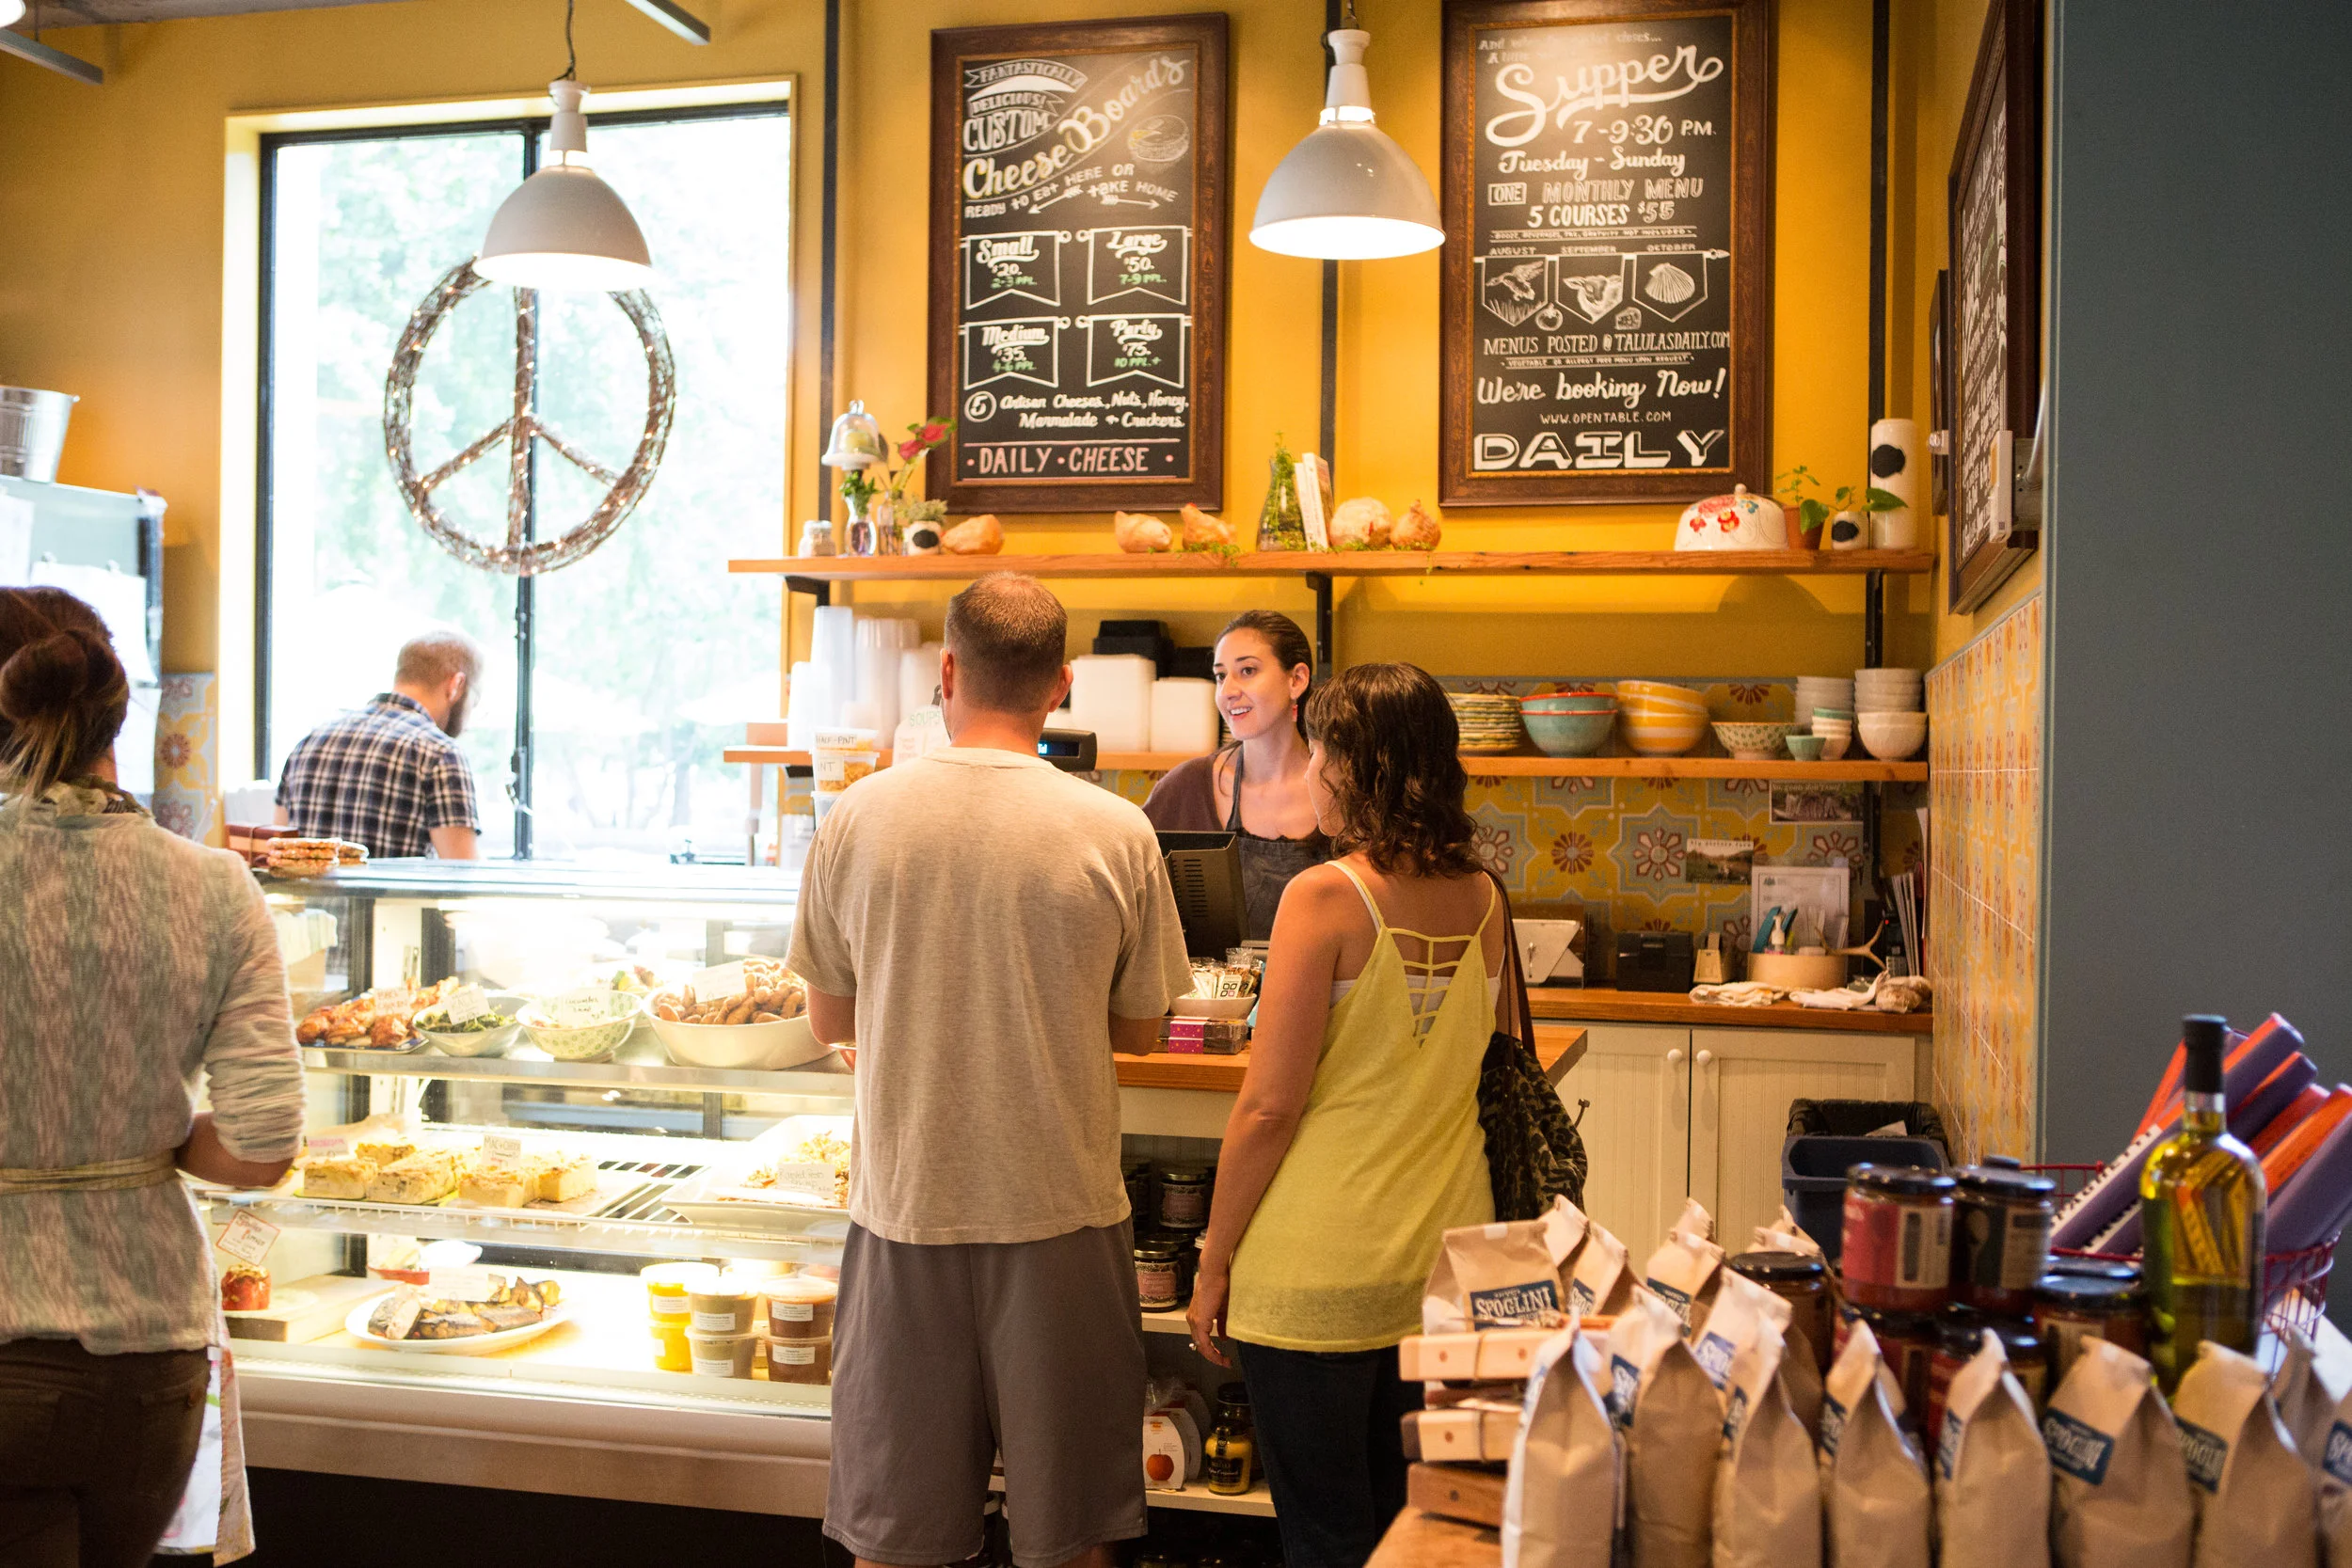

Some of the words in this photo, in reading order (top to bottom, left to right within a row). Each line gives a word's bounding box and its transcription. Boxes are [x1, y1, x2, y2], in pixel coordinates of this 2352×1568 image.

[1486, 44, 1724, 147] Supper
[963, 144, 1074, 199] Cheese
[1058, 55, 1191, 154] Boards
[963, 109, 1050, 151] CUSTOM
[1064, 166, 1104, 186] HERE
[1111, 163, 1136, 178] OR
[1498, 150, 1589, 182] Tuesday
[1610, 145, 1686, 177] Sunday
[1136, 182, 1179, 203] HOME
[1493, 185, 1523, 203] ONE
[1541, 179, 1635, 204] MONTHLY
[1644, 178, 1704, 200] MENU
[1527, 205, 1544, 229] 5
[1549, 204, 1630, 228] COURSES
[1638, 200, 1676, 224] $55
[976, 235, 1040, 267] Small
[1106, 230, 1168, 260] Large
[1489, 245, 1537, 256] AUGUST
[1561, 245, 1617, 255] SEPTEMBER
[1646, 243, 1696, 252] OCTOBER
[981, 325, 1050, 353] Medium
[1110, 318, 1163, 345] Party
[1484, 336, 1539, 356] MENUS
[1546, 334, 1598, 355] POSTED
[1614, 330, 1730, 352] TALULASDAILY.COM
[1477, 376, 1546, 404] We're
[1555, 372, 1645, 409] booking
[1657, 368, 1726, 400] Now!
[971, 395, 987, 417] 5
[1539, 410, 1672, 425] WWW.OPENTABLE.COM
[1019, 412, 1098, 430] Marmalade
[979, 447, 1052, 474] DAILY
[1068, 446, 1150, 472] CHEESE
[1473, 429, 1724, 470] DAILY
